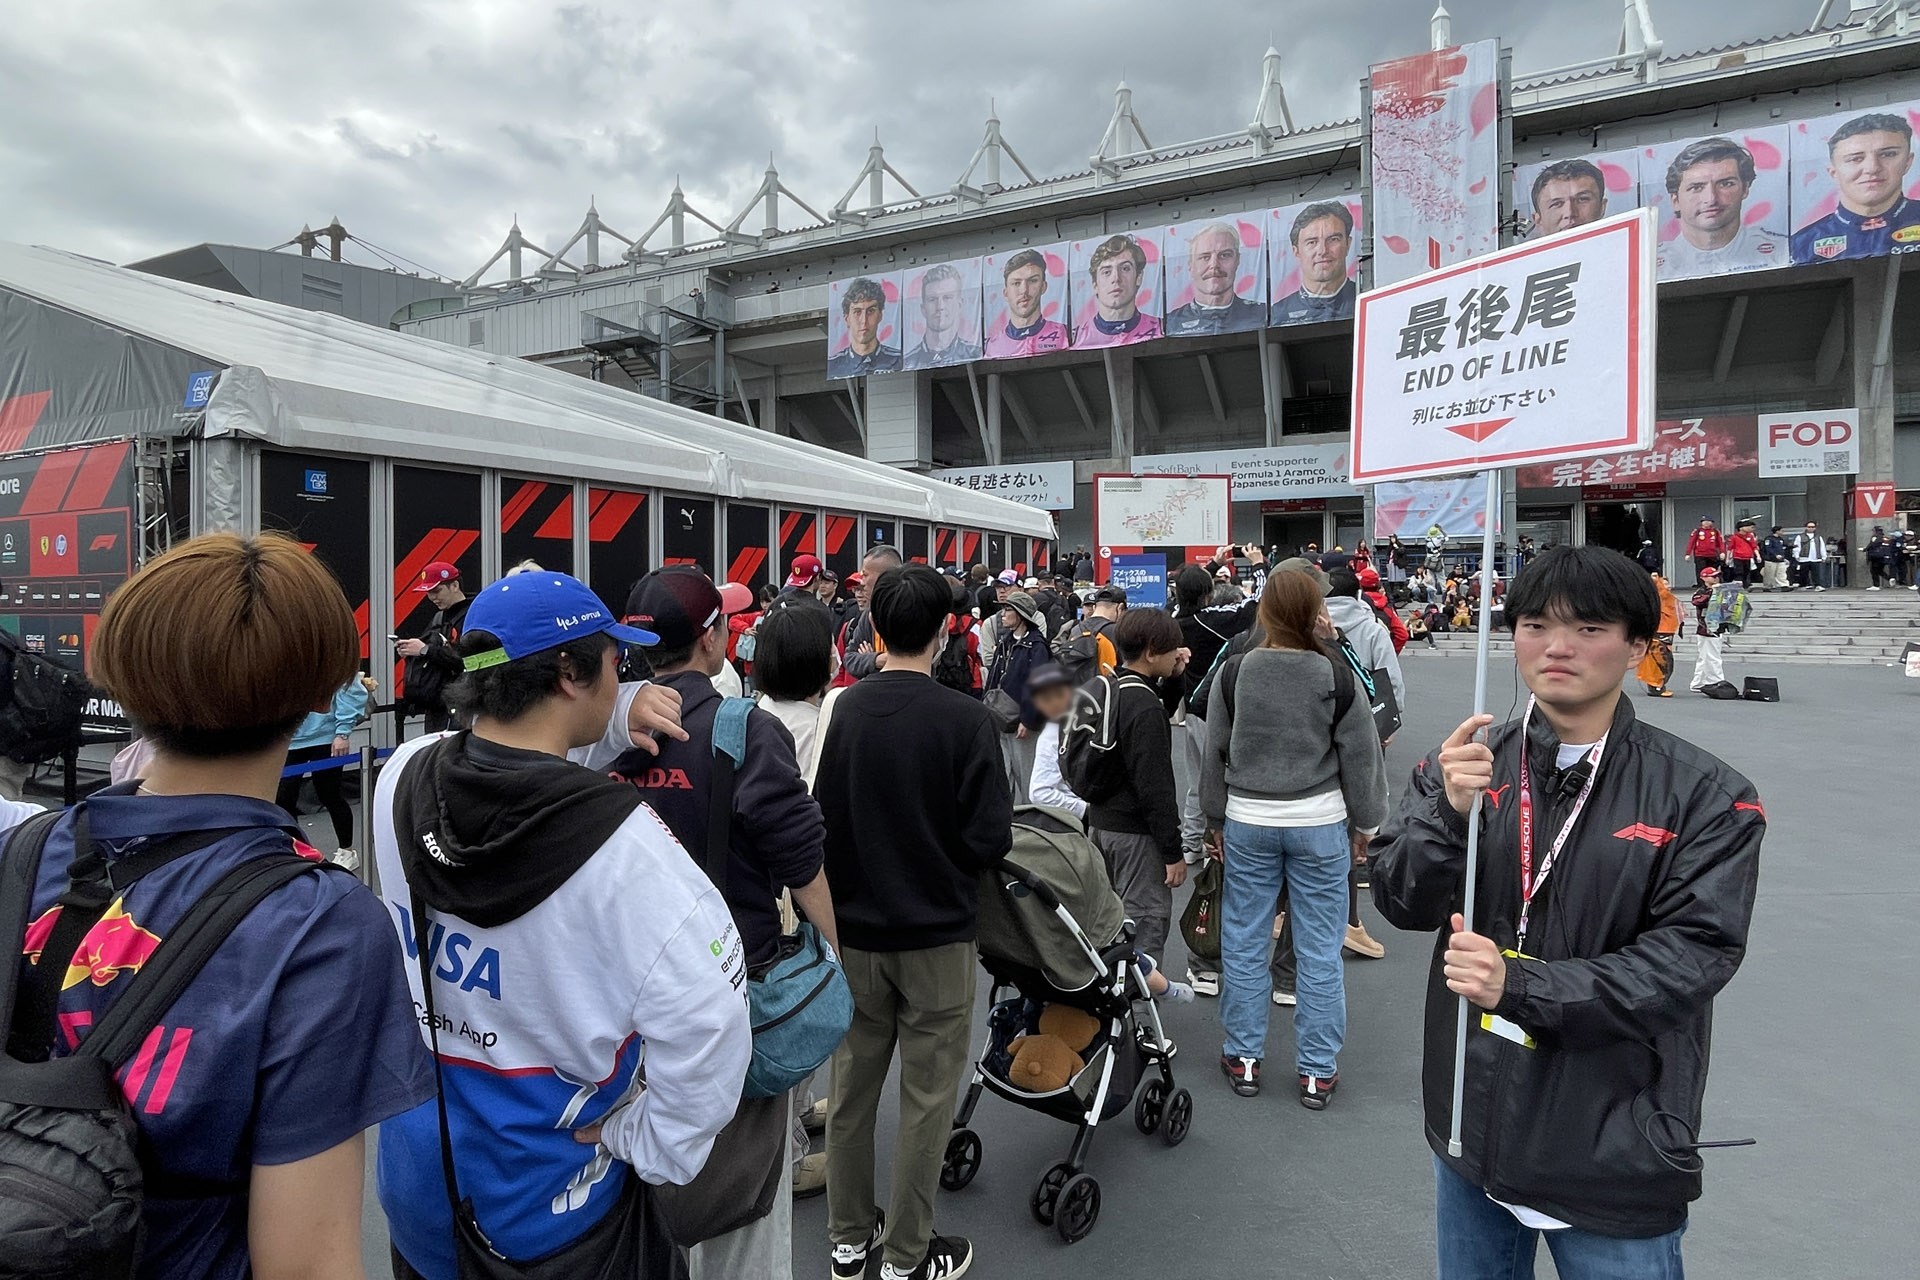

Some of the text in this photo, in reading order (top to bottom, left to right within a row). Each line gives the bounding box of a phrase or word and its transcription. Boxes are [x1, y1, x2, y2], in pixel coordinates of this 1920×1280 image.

[1395, 261, 1582, 361] 最後尾
[1402, 338, 1570, 394] END OF LINE
[1411, 387, 1556, 426] 列にお並び下さい
[1655, 418, 1707, 441] ース
[1769, 421, 1852, 447] FOD
[1157, 463, 1202, 475] SoftBank
[1231, 457, 1319, 469] Event Supporter
[1231, 468, 1326, 480] Formula 1 Aramco
[1552, 443, 1708, 487] 完全生中継!
[932, 472, 1049, 490] りを見逃さない。
[1230, 475, 1349, 489] Japanese Grand Prix 2
[1863, 492, 1886, 515] V
[391, 900, 502, 1001] VISA
[459, 1021, 498, 1050] App
